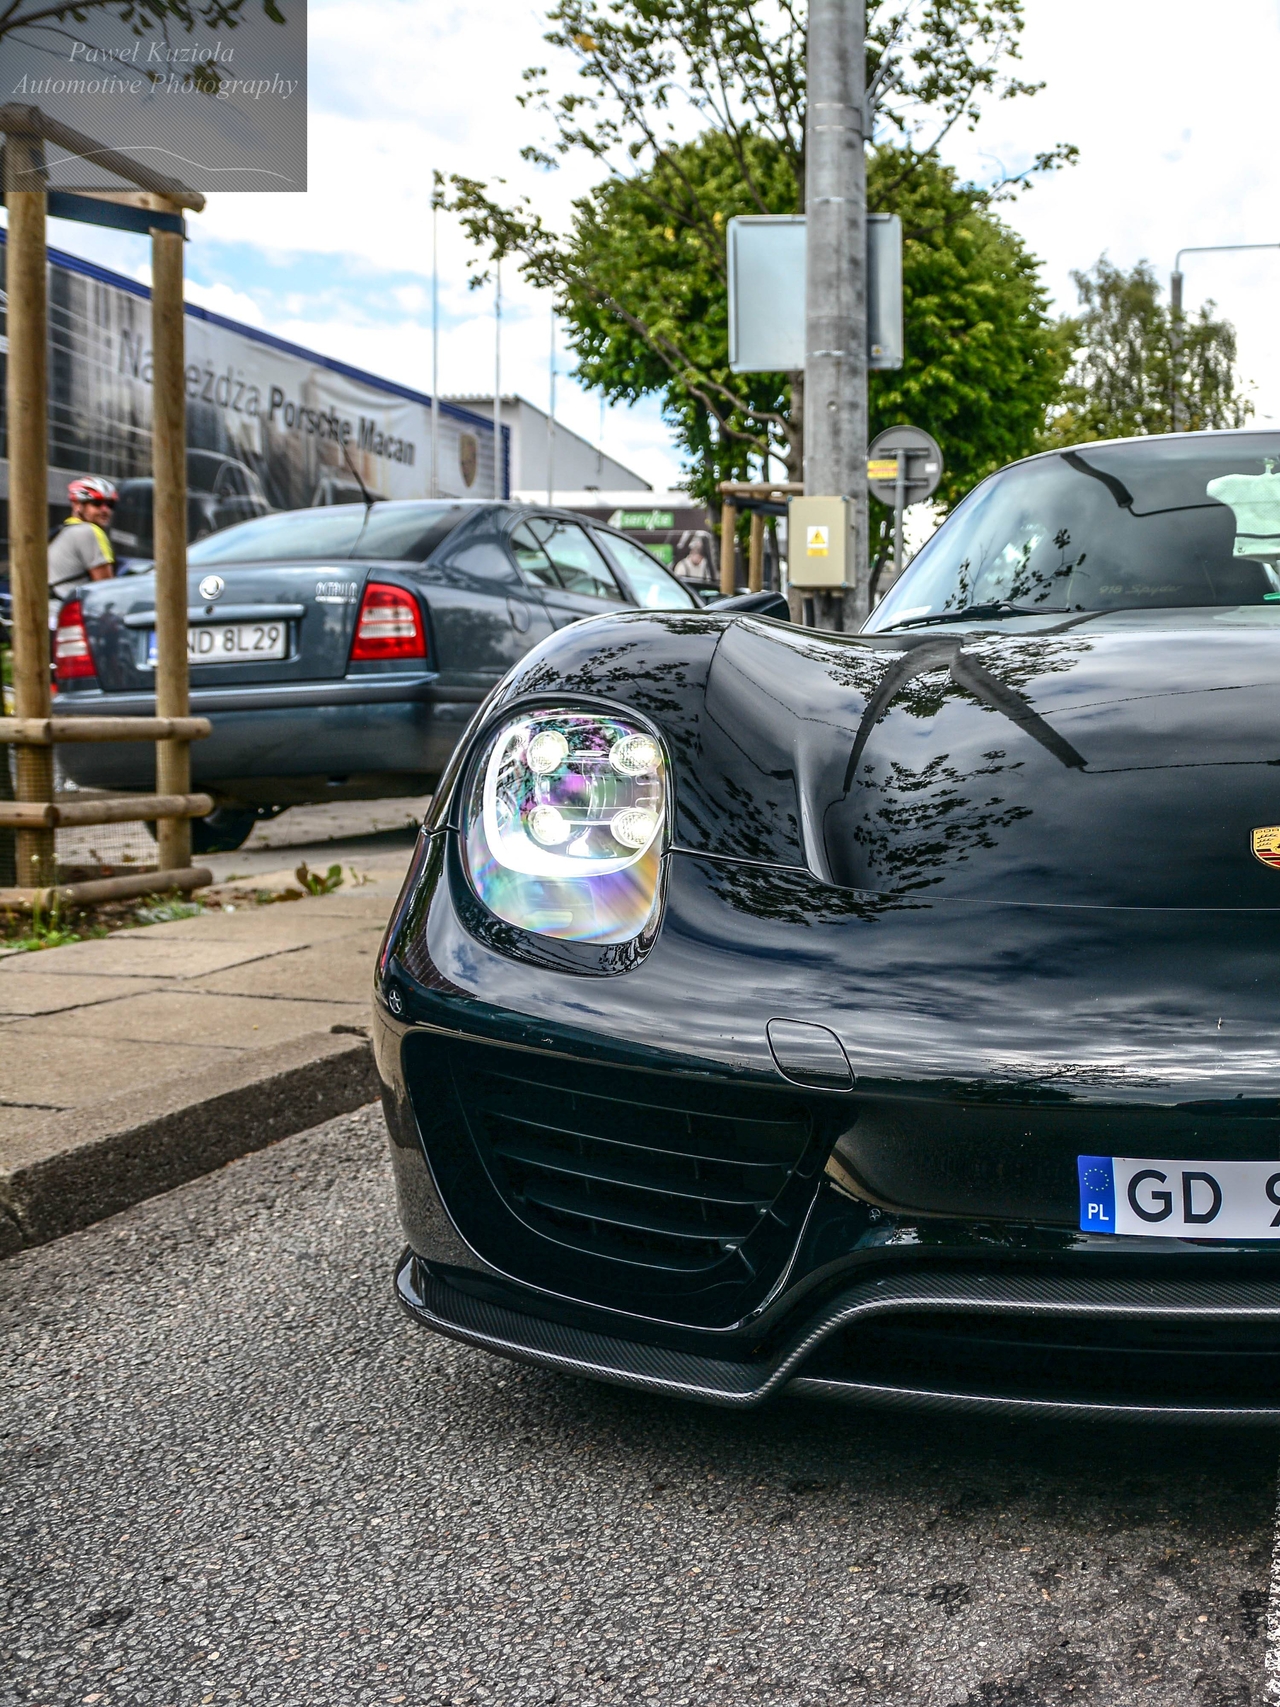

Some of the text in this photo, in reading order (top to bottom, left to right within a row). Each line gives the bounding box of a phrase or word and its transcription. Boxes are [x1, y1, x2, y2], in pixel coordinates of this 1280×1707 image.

[269, 384, 351, 445] Porsche
[357, 415, 416, 466] Macan
[224, 626, 280, 652] 8L29
[1088, 1203, 1109, 1222] PL
[1127, 1169, 1223, 1225] GD
